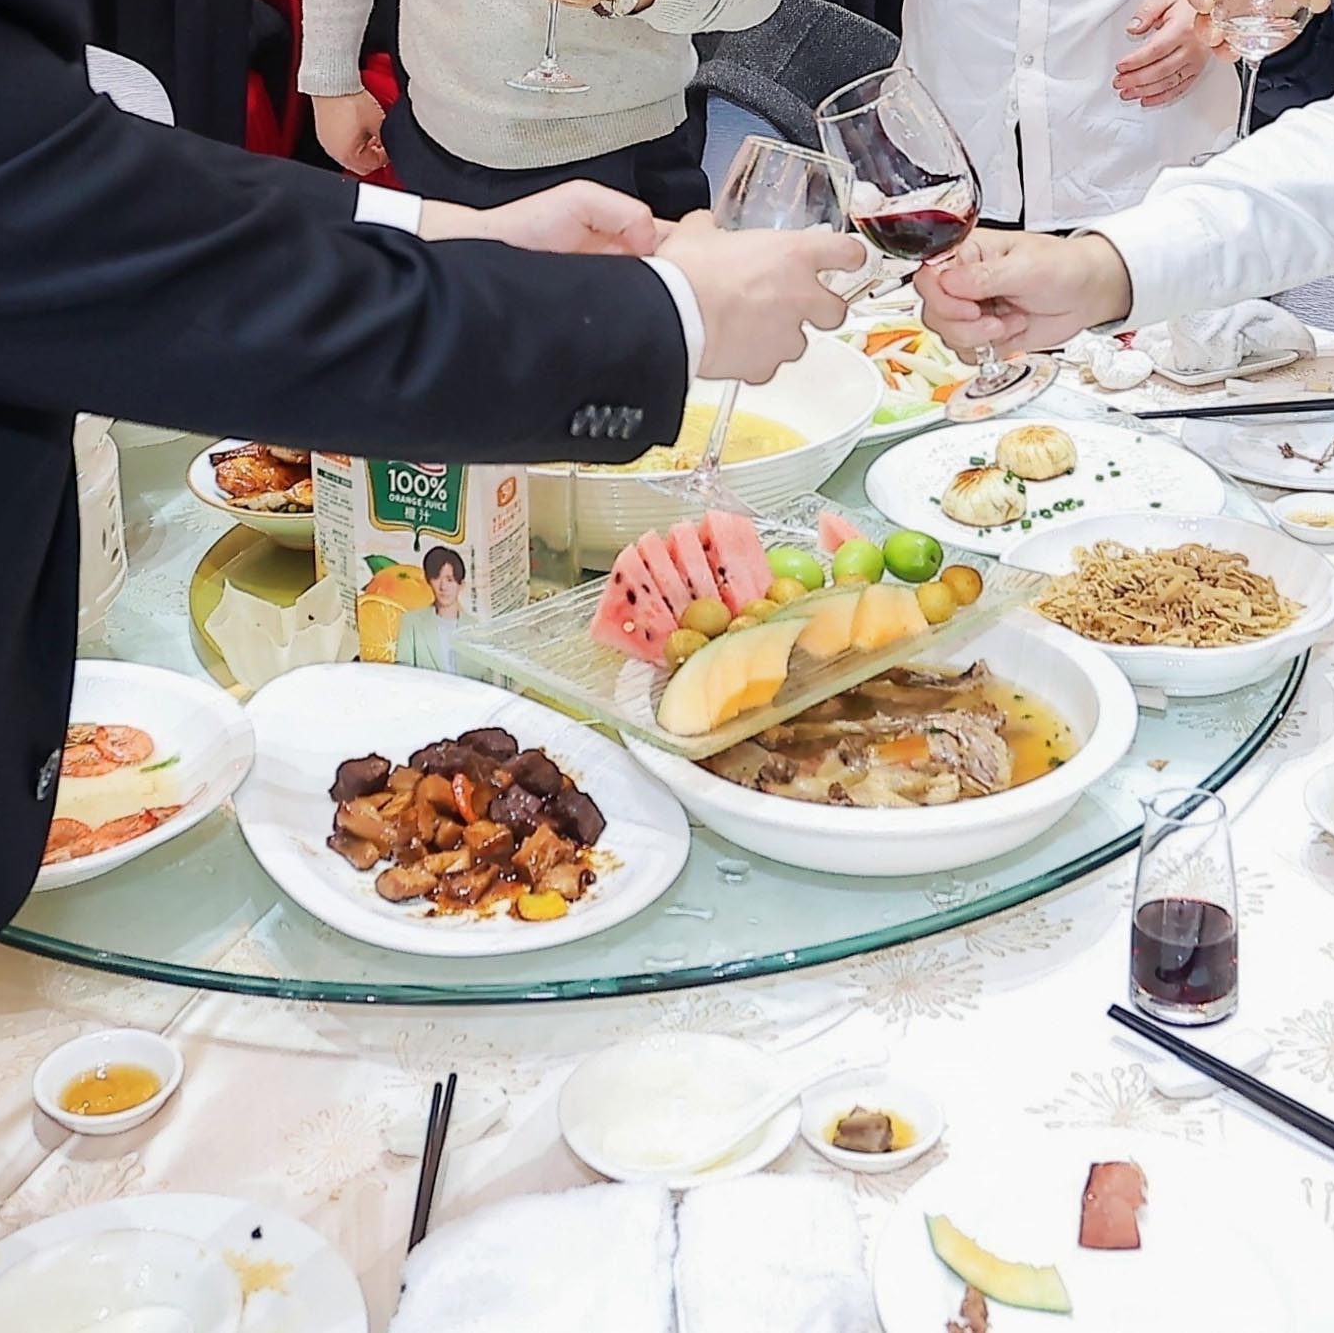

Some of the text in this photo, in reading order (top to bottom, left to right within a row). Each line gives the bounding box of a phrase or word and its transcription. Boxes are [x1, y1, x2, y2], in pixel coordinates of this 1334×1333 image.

[388, 469, 447, 501] 100%
[388, 493, 447, 512] ORANGE JUICE
